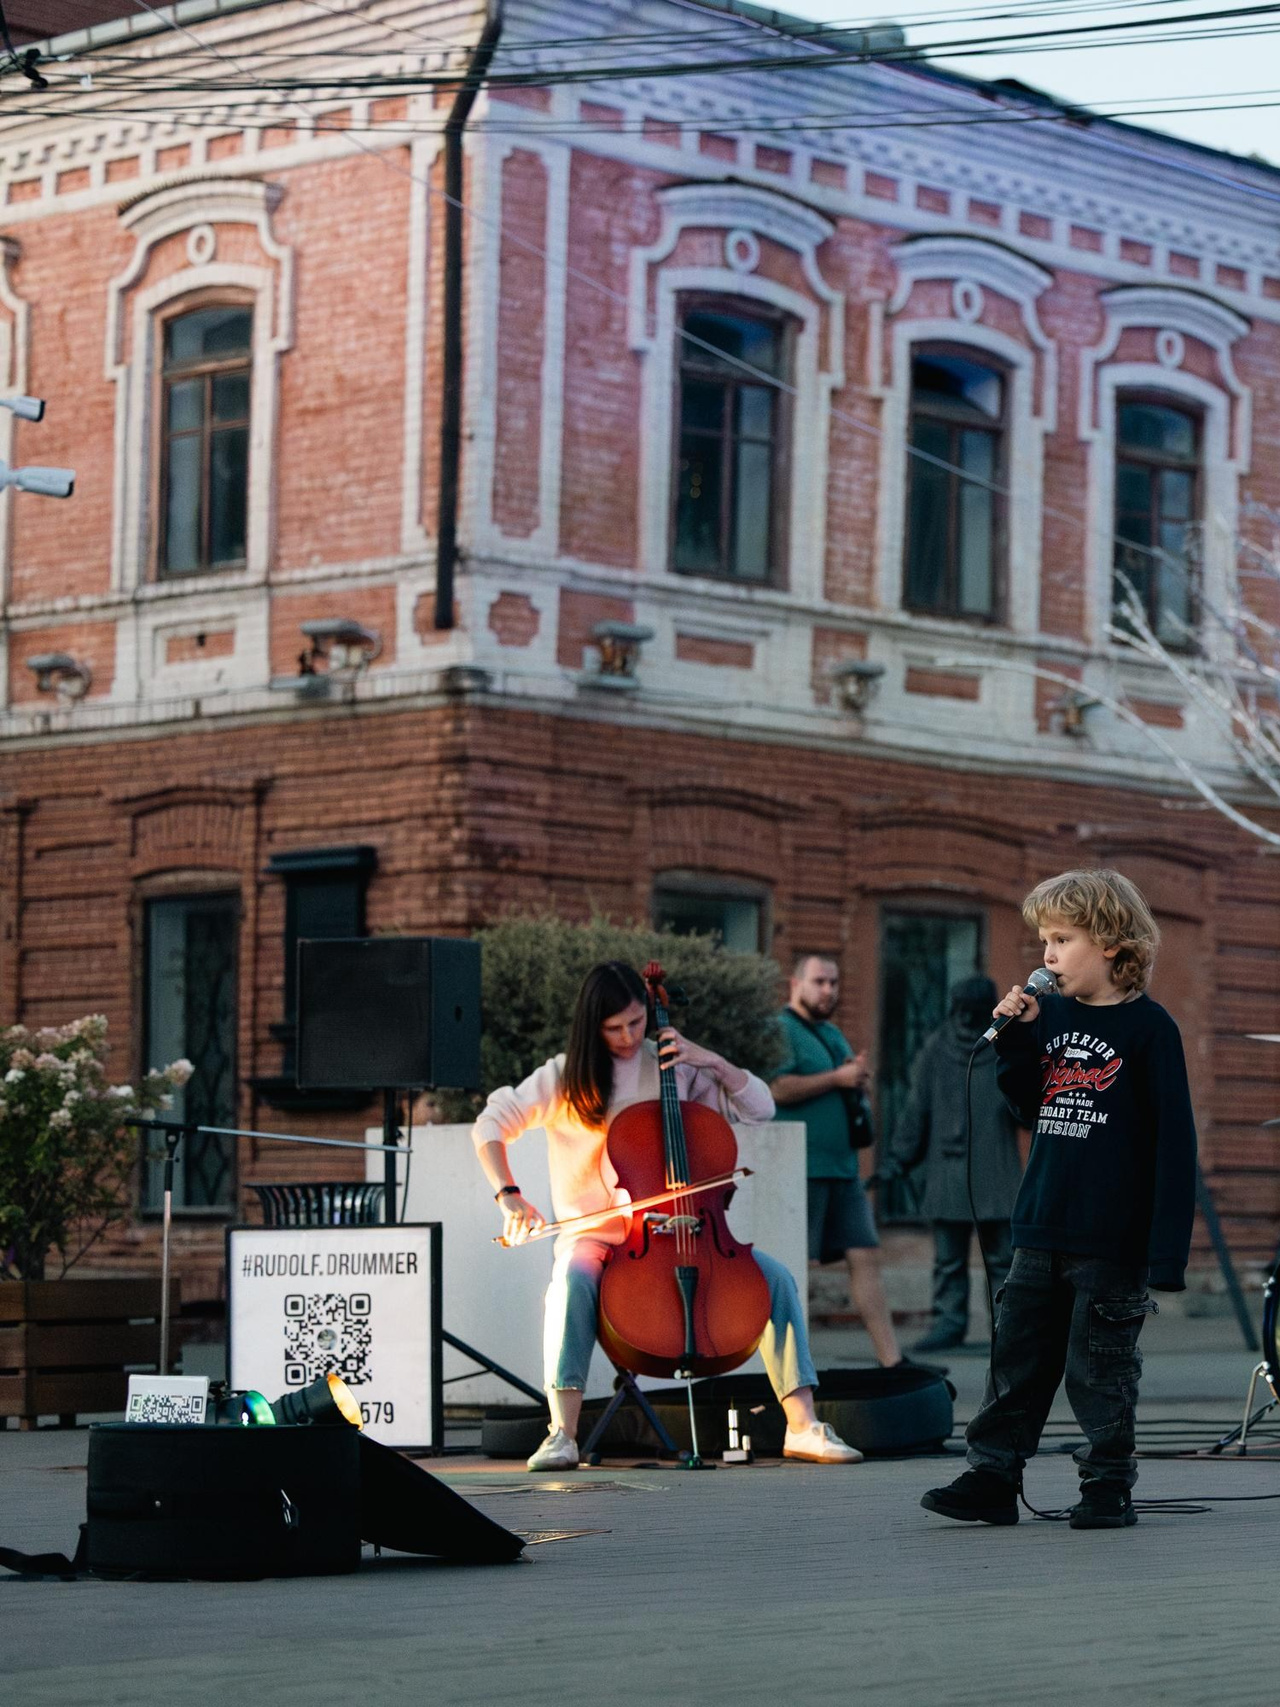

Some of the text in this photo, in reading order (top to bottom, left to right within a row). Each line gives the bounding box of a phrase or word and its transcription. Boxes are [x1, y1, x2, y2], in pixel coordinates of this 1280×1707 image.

[1045, 1031, 1116, 1061] SUPERIOR
[1055, 1096, 1095, 1108] UNION MADE
[1039, 1105, 1109, 1124] ENDARY TEAM
[1037, 1119, 1092, 1139] IVISION
